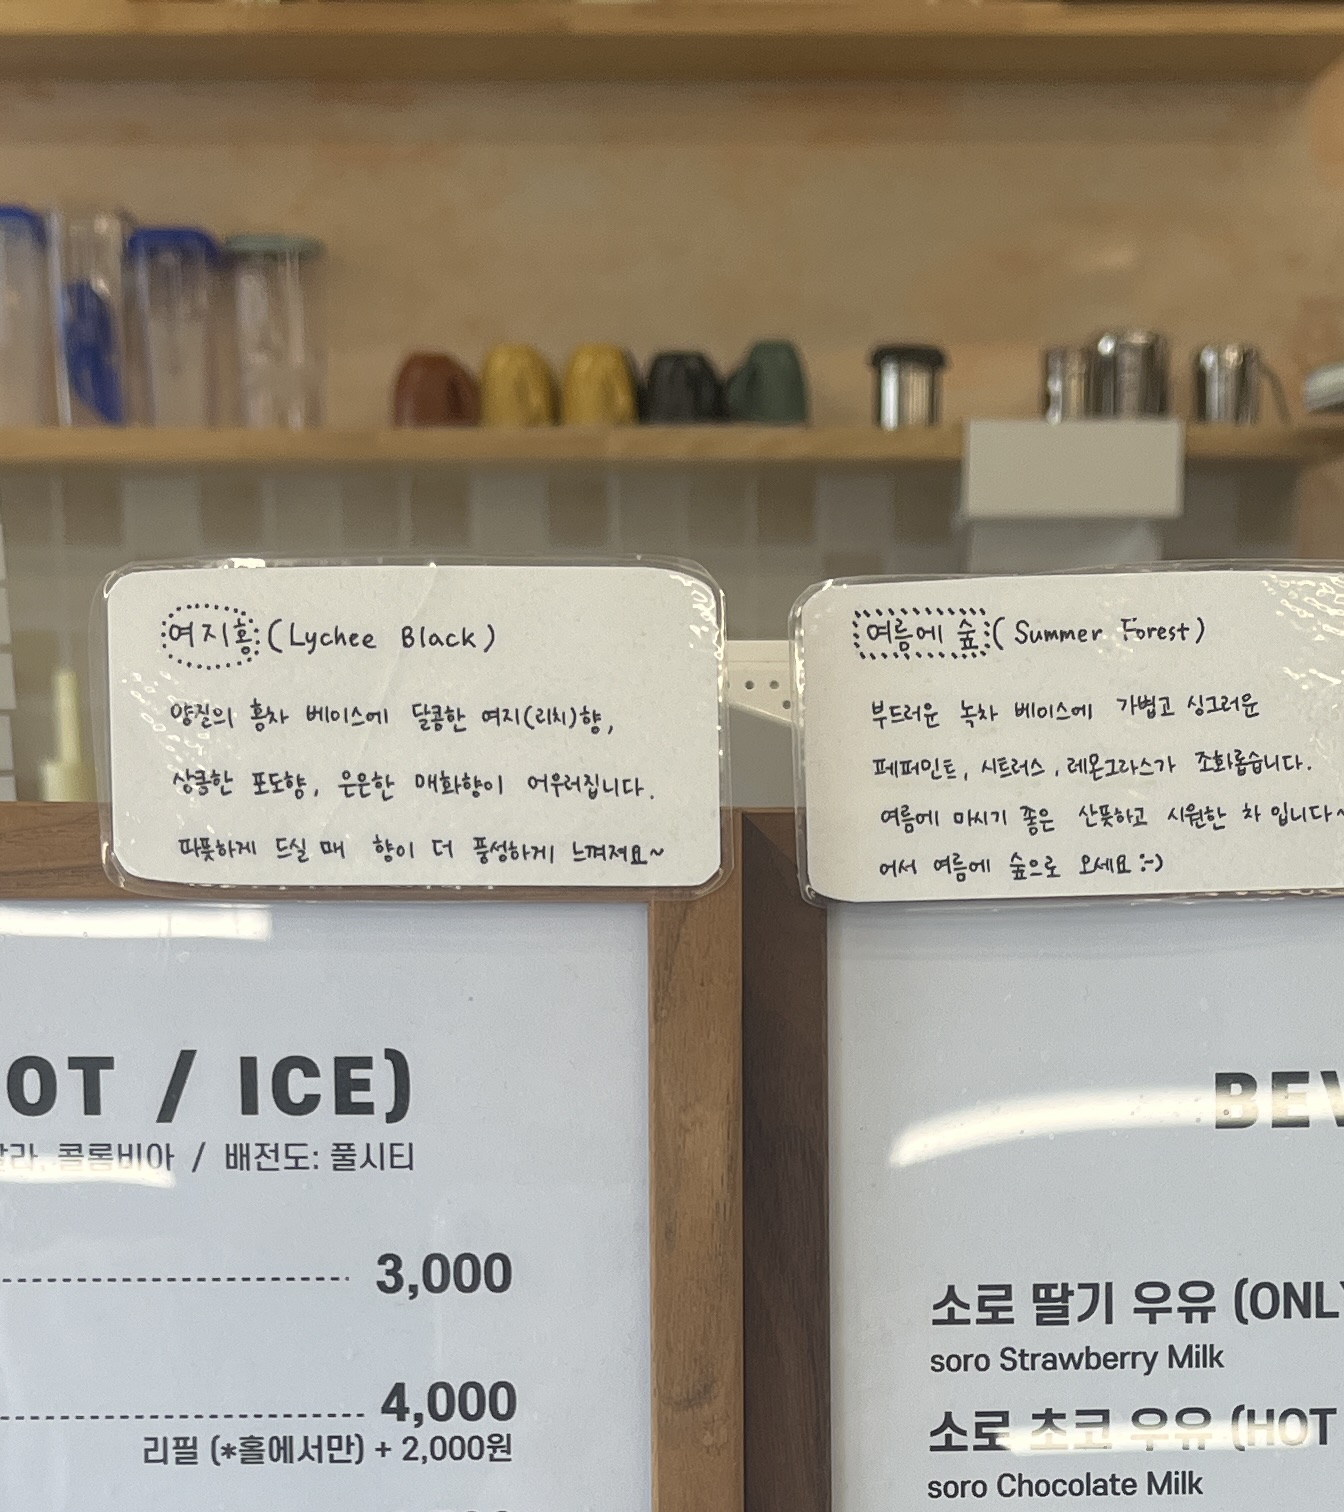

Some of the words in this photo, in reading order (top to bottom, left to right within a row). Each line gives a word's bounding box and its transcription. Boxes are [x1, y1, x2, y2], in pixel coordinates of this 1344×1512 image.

[169, 618, 253, 658] 여지홍
[268, 619, 376, 654] (Lychee
[402, 624, 494, 652] Black)
[867, 618, 945, 654] 여름에
[957, 619, 978, 650] 숲
[993, 617, 1102, 650] (Summer
[1121, 617, 1204, 644] Forest)
[171, 703, 233, 729] 양질의
[250, 698, 289, 732] 홍차
[306, 705, 388, 726] 베이스에
[412, 703, 466, 733] 달콤한
[872, 701, 939, 729] 부드러운
[961, 700, 998, 728] 녹차
[1015, 702, 1092, 720] 베이스에
[1117, 695, 1174, 719] 가볍고
[1188, 693, 1259, 718] 싱그러운
[873, 758, 967, 781] 페퍼민트,
[1067, 753, 1176, 781] 레몬그라스가
[1195, 749, 1311, 776] 조화롭습니다.
[252, 771, 318, 799] 포도향,
[338, 770, 394, 801] 은은한
[416, 770, 502, 798] 매화향이
[528, 773, 654, 799] 어우러집니다.
[156, 1050, 197, 1123] /
[240, 1048, 410, 1124] ICE)
[226, 1143, 318, 1171] 배전도:
[331, 1143, 413, 1171] 풀시티
[377, 1253, 511, 1300] 3,000
[932, 1284, 1014, 1325] 소로
[1033, 1282, 1113, 1326] 딸기
[1134, 1281, 1216, 1324] 우유
[931, 1354, 990, 1372] soro
[1000, 1346, 1158, 1376] Strawberry
[1168, 1344, 1224, 1368] Milk
[381, 1381, 516, 1428] 4,000
[144, 1436, 198, 1465] 리필
[375, 1442, 391, 1457] +
[402, 1434, 511, 1464] 2,000원
